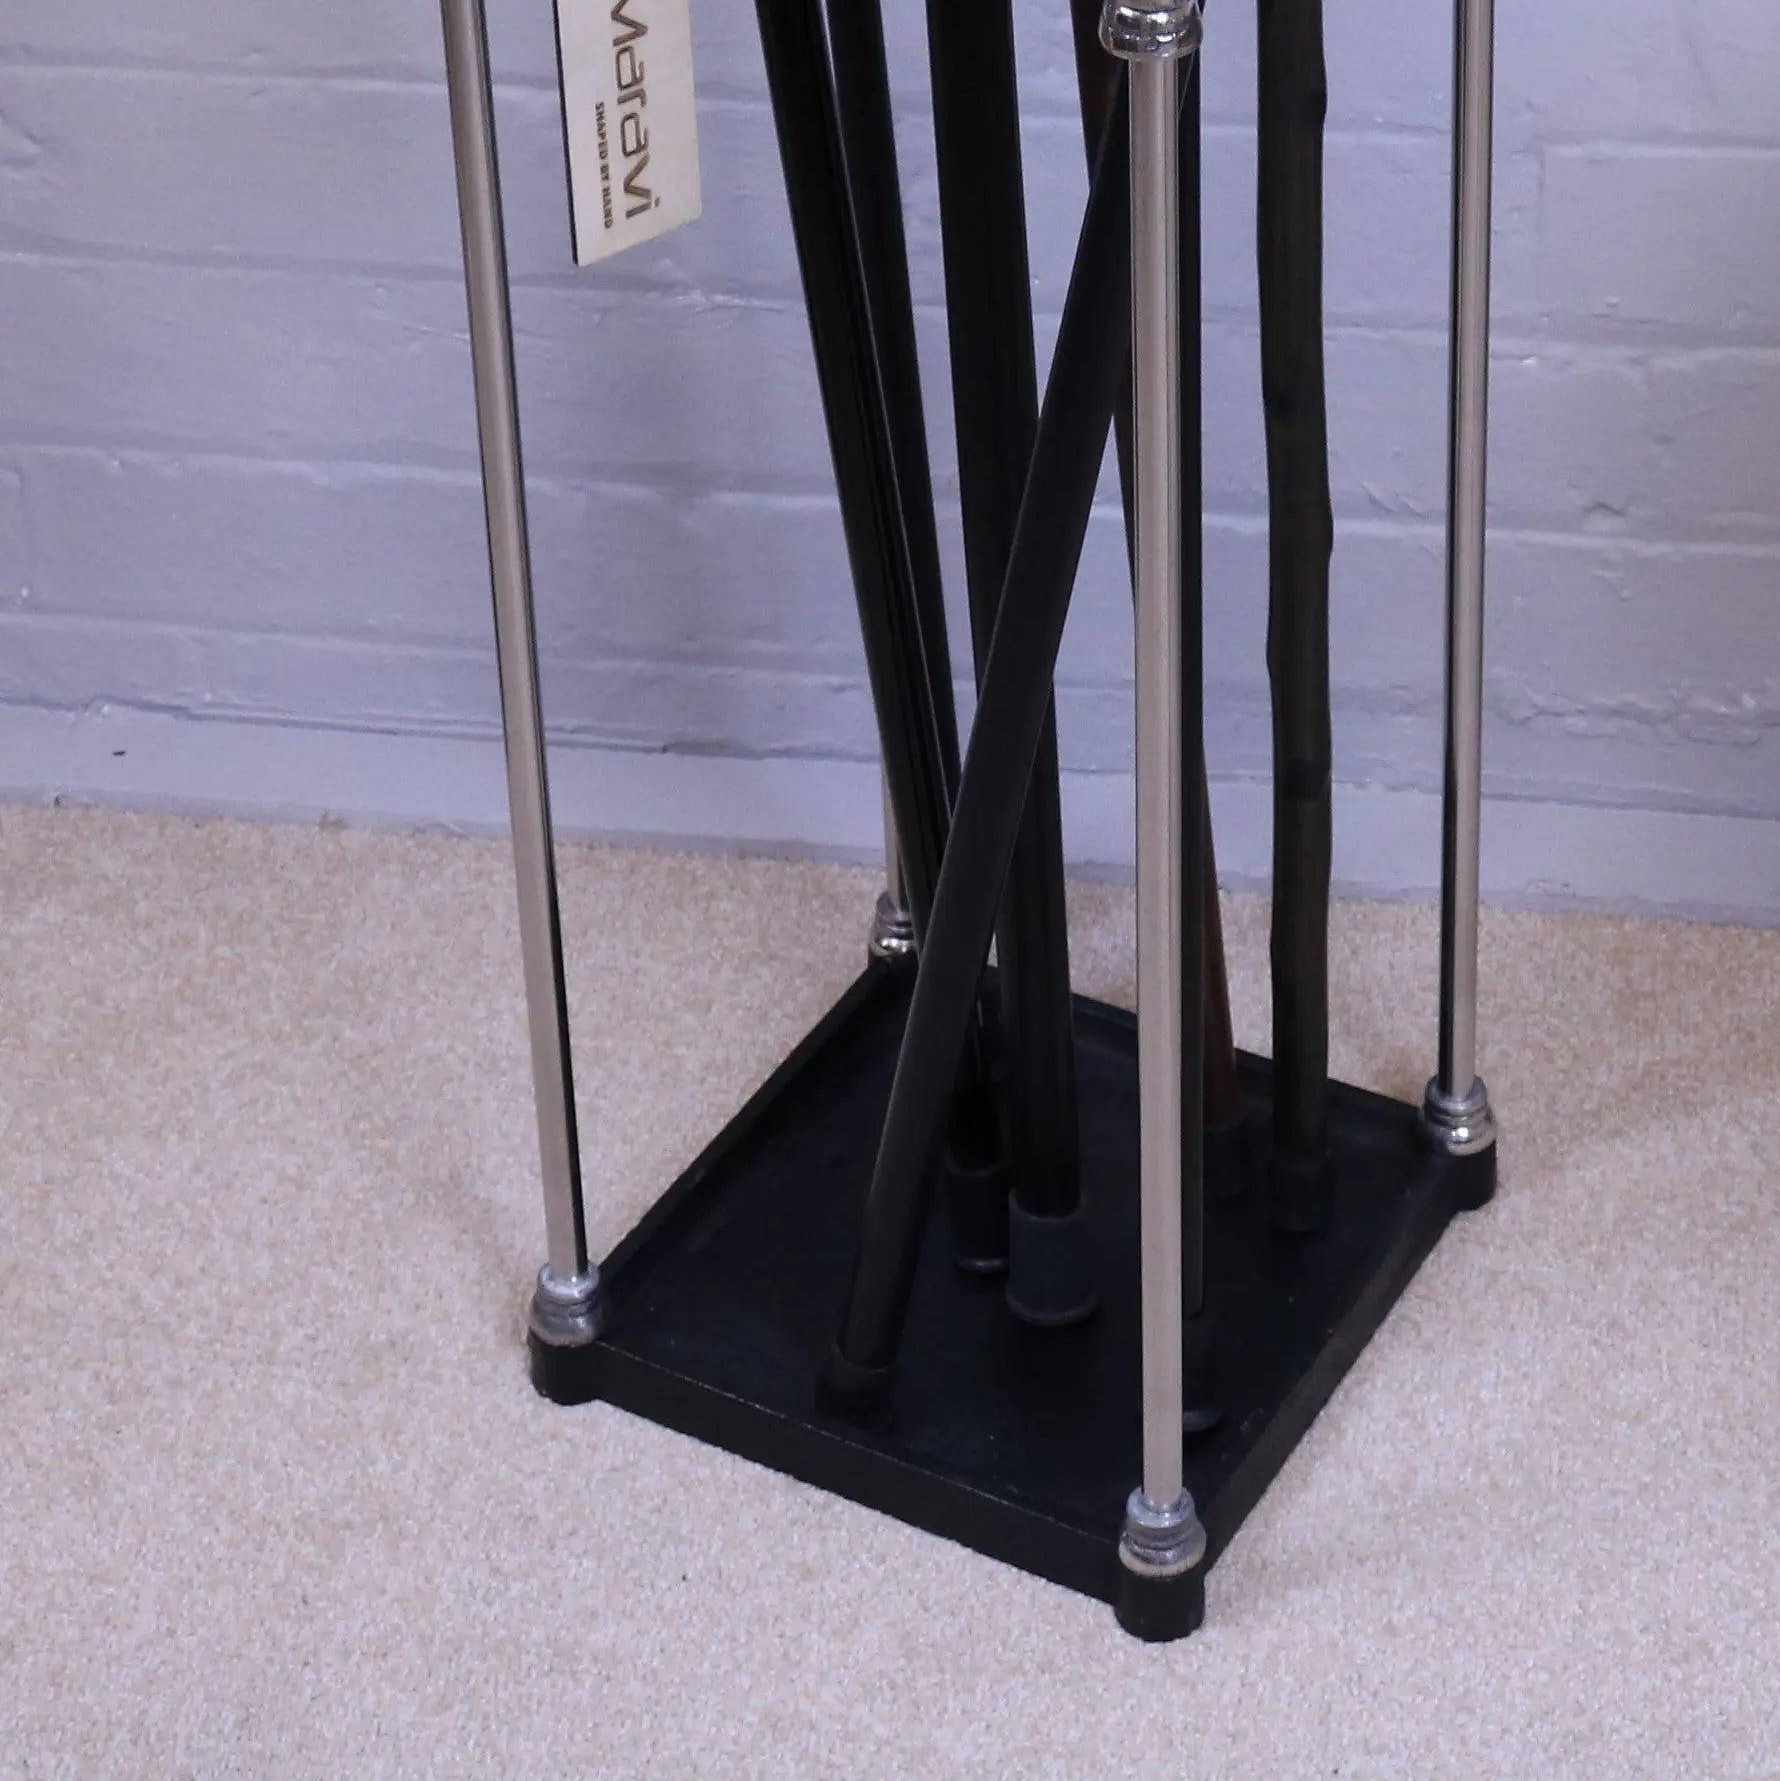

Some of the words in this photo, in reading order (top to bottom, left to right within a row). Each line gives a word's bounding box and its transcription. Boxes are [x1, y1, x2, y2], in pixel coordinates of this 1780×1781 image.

[595, 102, 608, 160] SHAPED
[600, 163, 609, 181] BY
[602, 186, 613, 229] HAND
